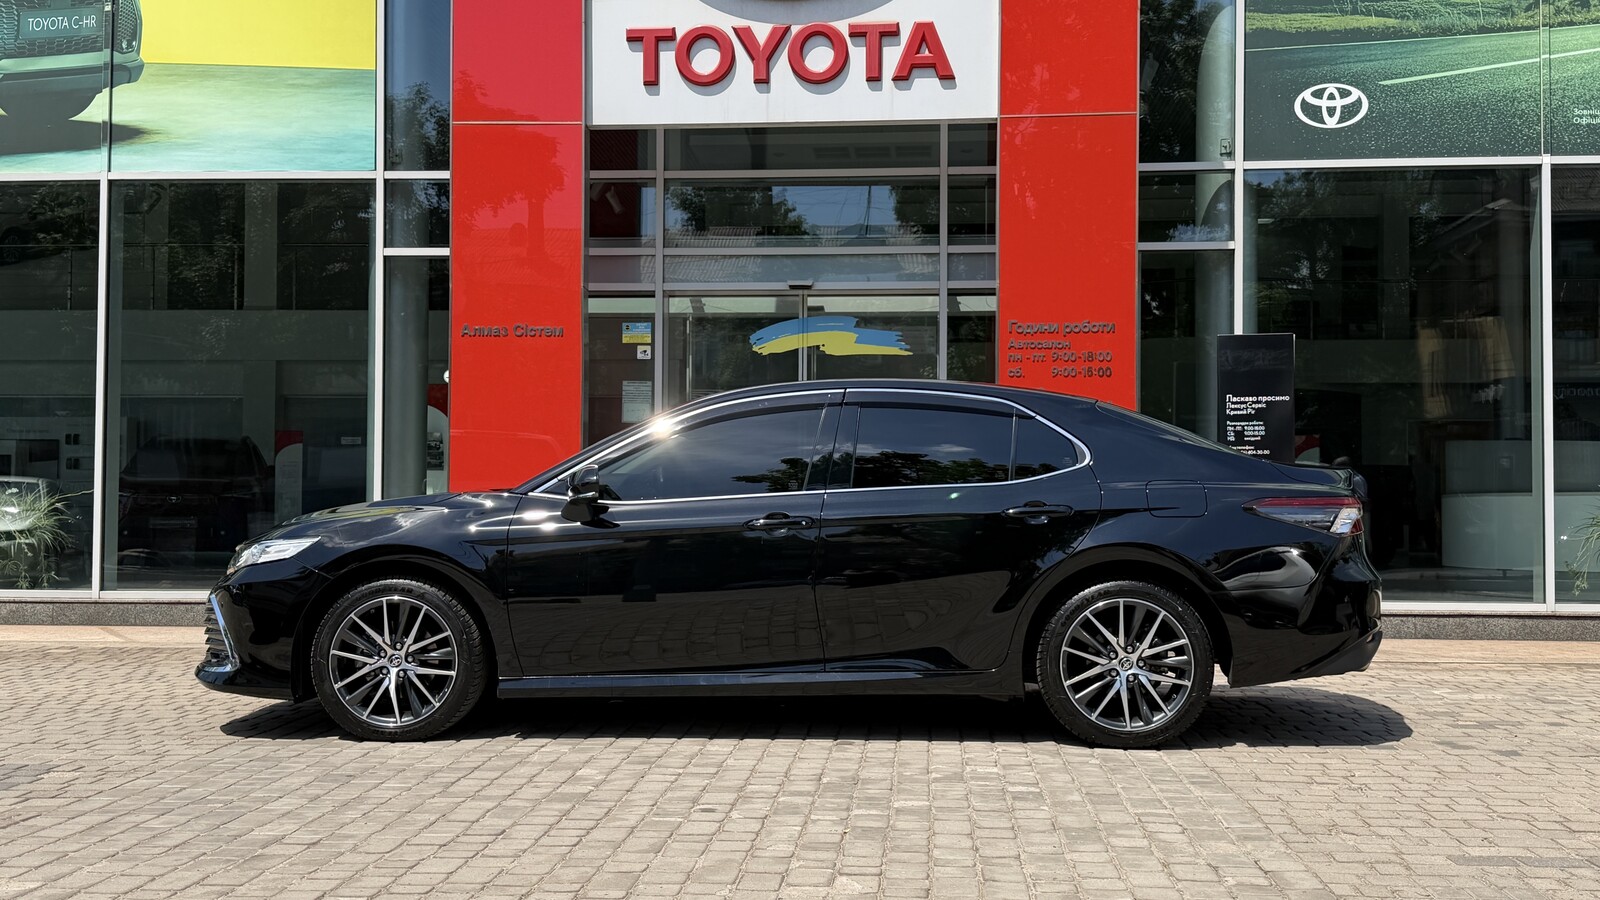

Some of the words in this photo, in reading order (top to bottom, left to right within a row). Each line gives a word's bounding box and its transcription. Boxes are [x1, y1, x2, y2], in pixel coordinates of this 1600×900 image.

[28, 17, 69, 31] TOYOTA
[71, 15, 97, 28] C-HR
[626, 21, 955, 86] TOYOTA
[461, 323, 509, 337] Алмаз
[513, 323, 564, 337] Сістем
[1008, 320, 1059, 336] Години
[1063, 320, 1115, 337] роботи
[1008, 339, 1071, 350] Автосалон
[1008, 367, 1025, 378] сб.
[1226, 394, 1257, 402] Ласкаво
[1258, 395, 1290, 403] просимо
